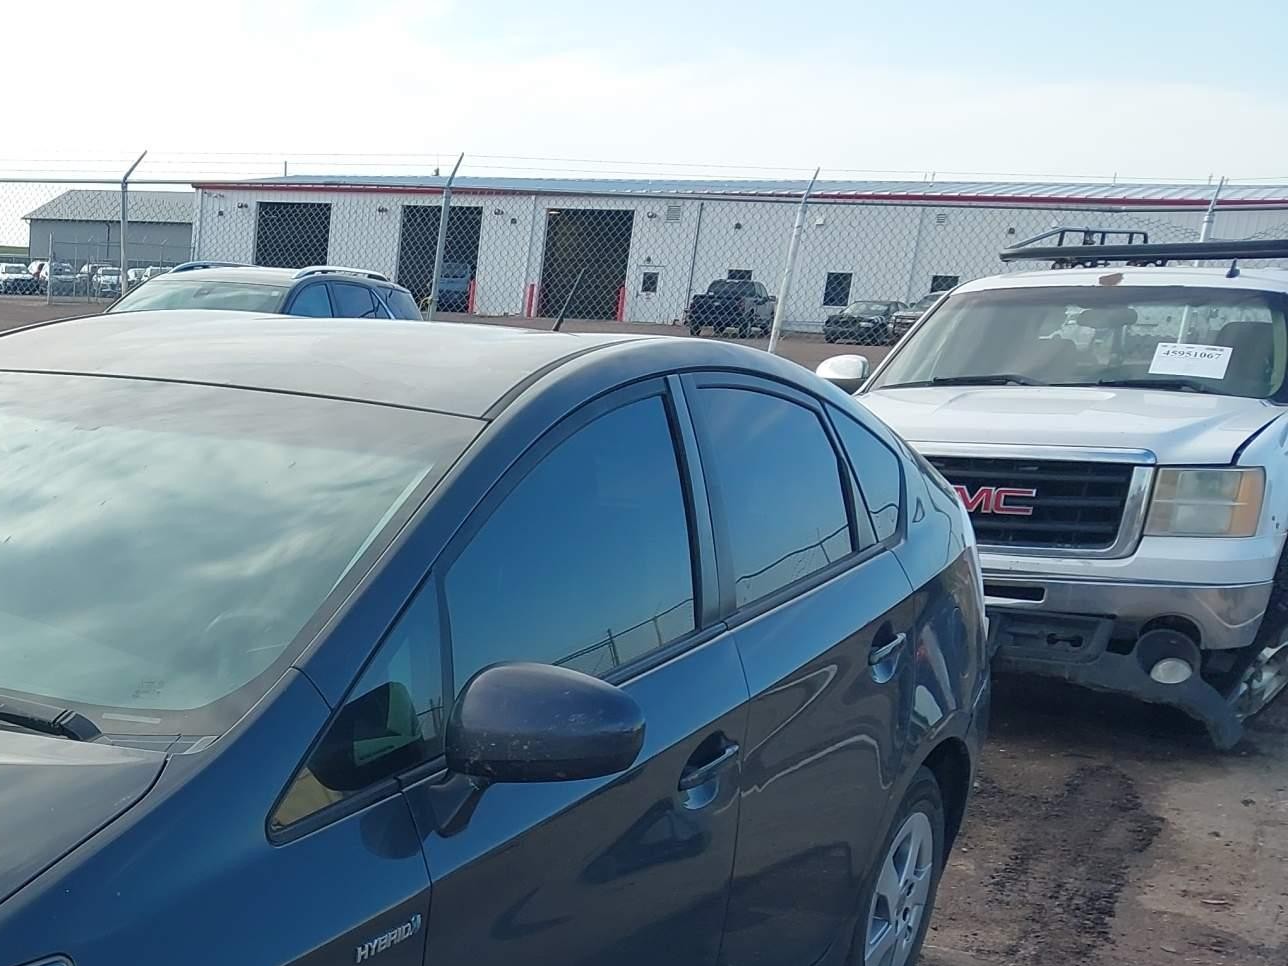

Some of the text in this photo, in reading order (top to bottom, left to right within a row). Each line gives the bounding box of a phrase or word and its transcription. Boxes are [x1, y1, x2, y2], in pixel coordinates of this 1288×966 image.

[1162, 349, 1222, 360] 45951067
[952, 485, 1037, 516] MC
[356, 922, 413, 963] HYBRID
